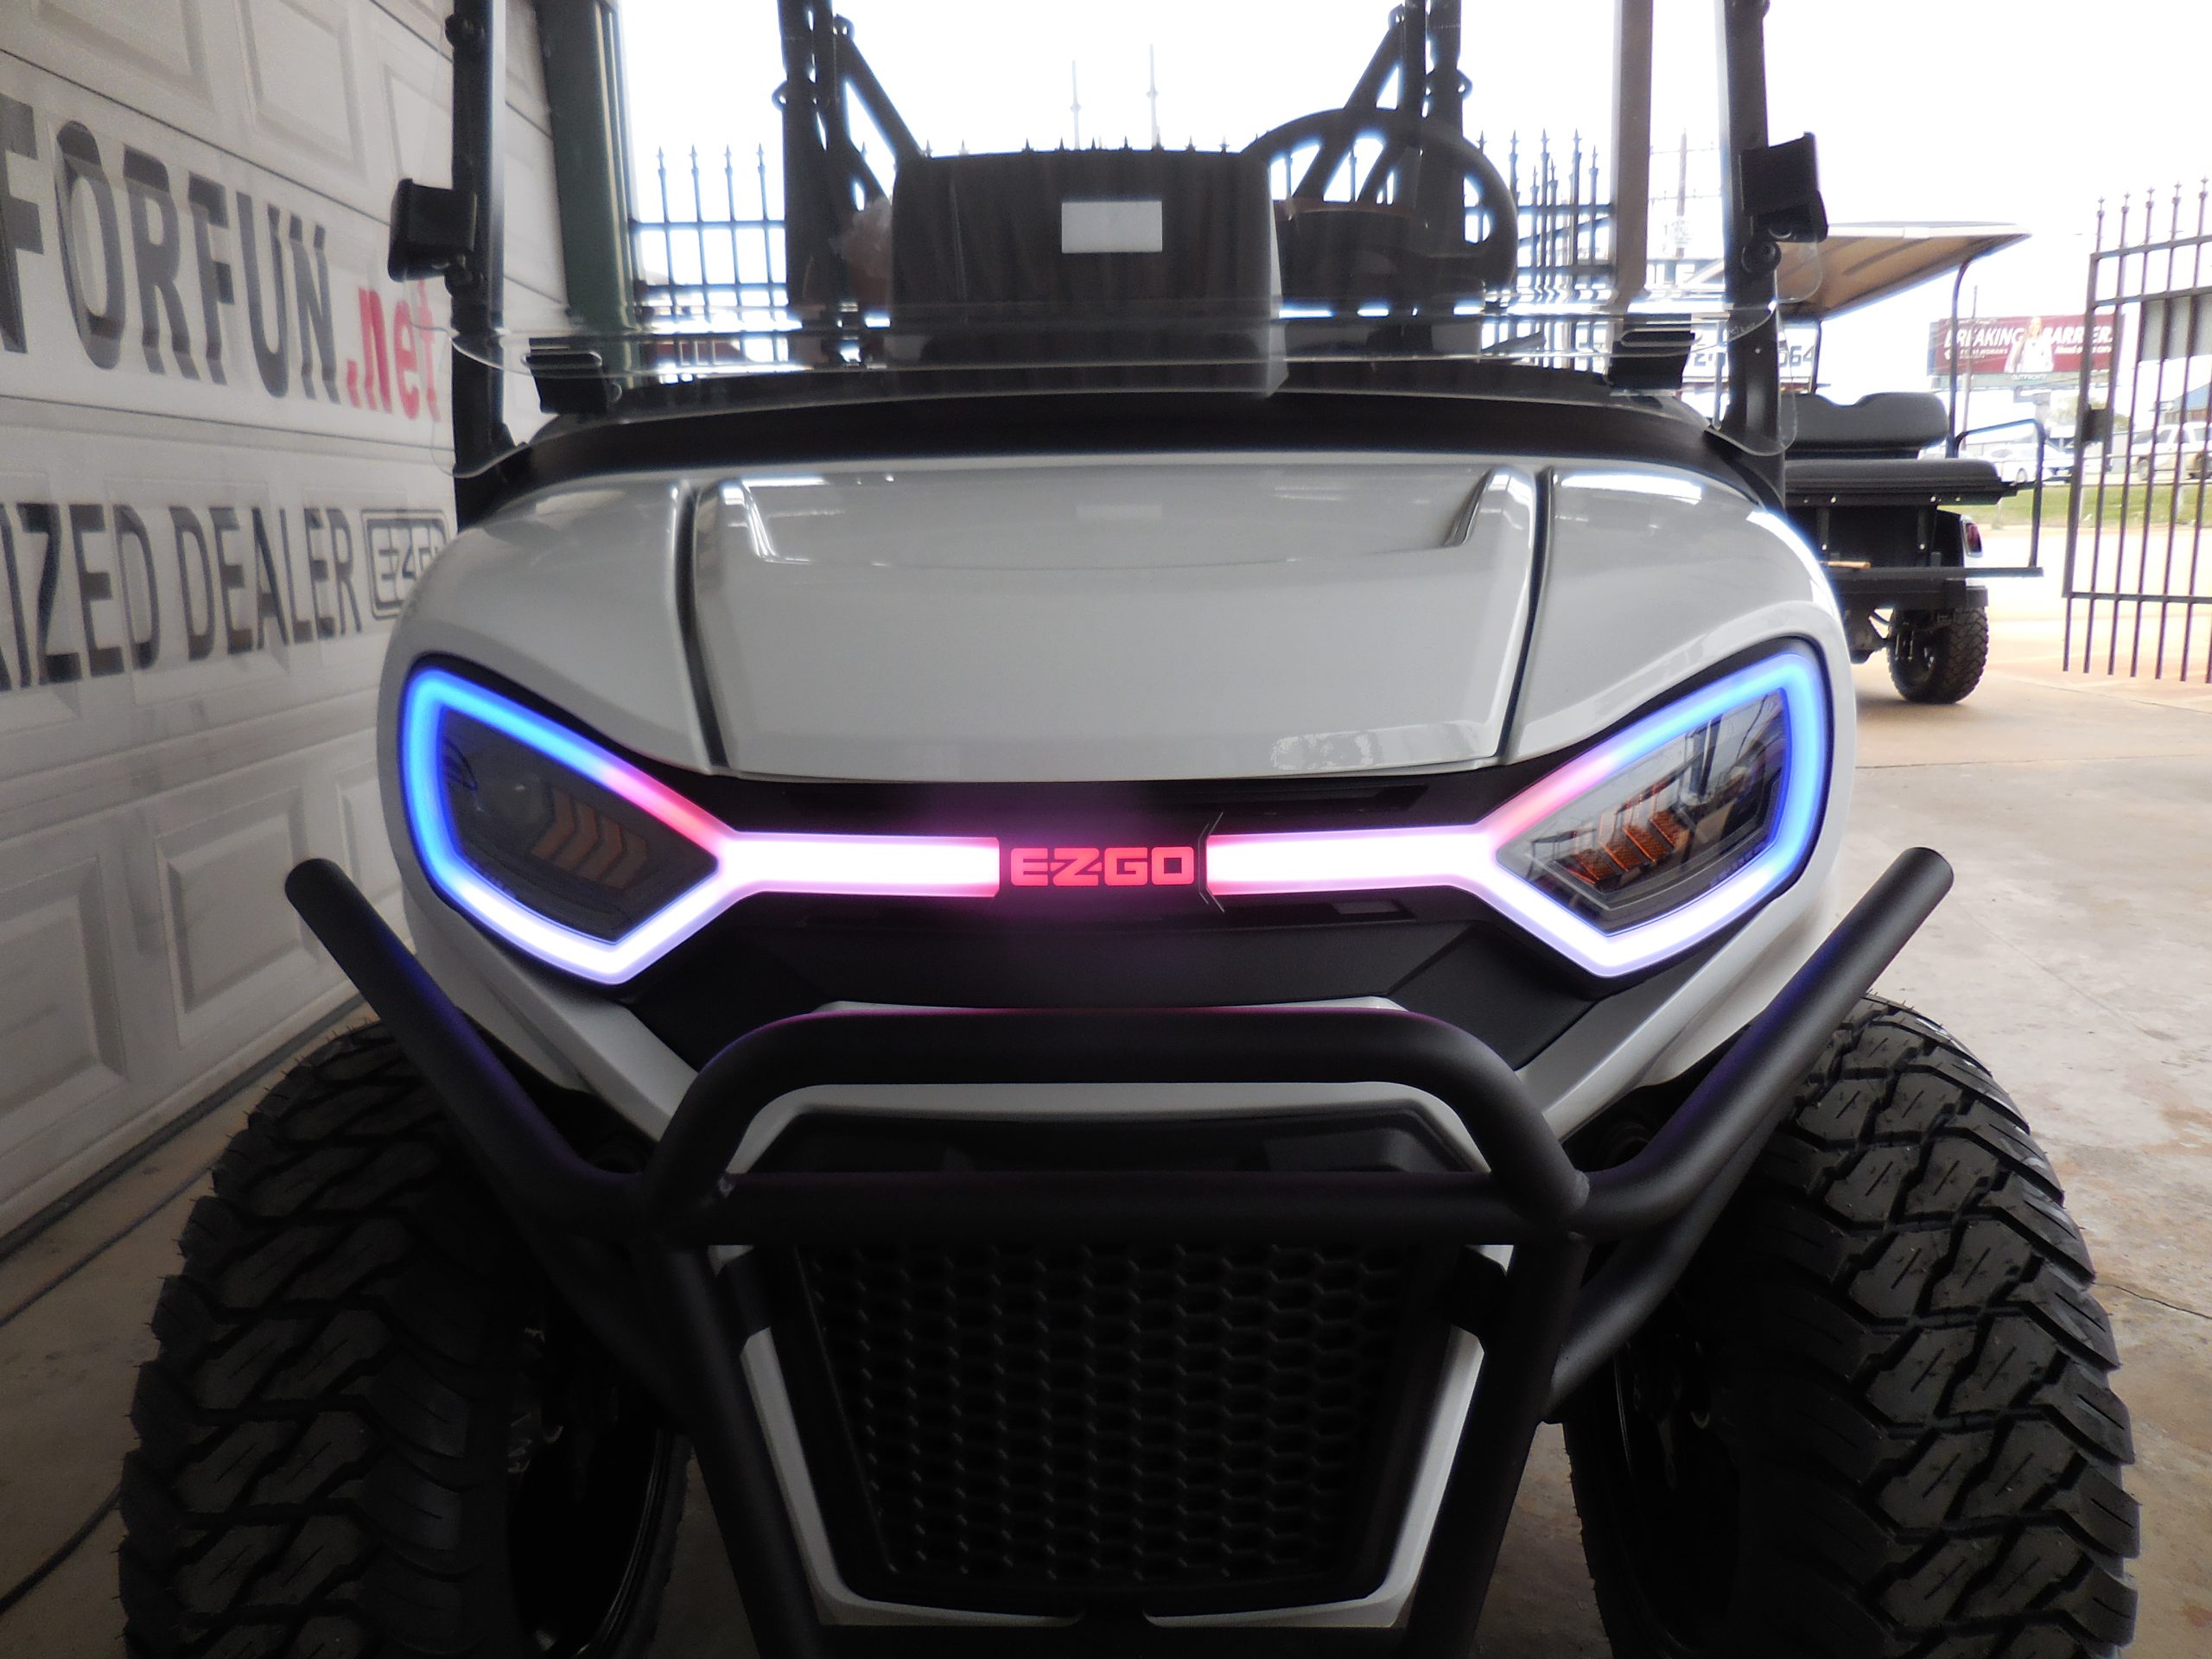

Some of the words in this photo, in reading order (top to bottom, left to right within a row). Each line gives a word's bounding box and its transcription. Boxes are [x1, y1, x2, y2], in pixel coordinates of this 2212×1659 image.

[0, 501, 160, 690] IZED
[168, 505, 362, 662] DEALER
[1010, 846, 1195, 887] EZGO
